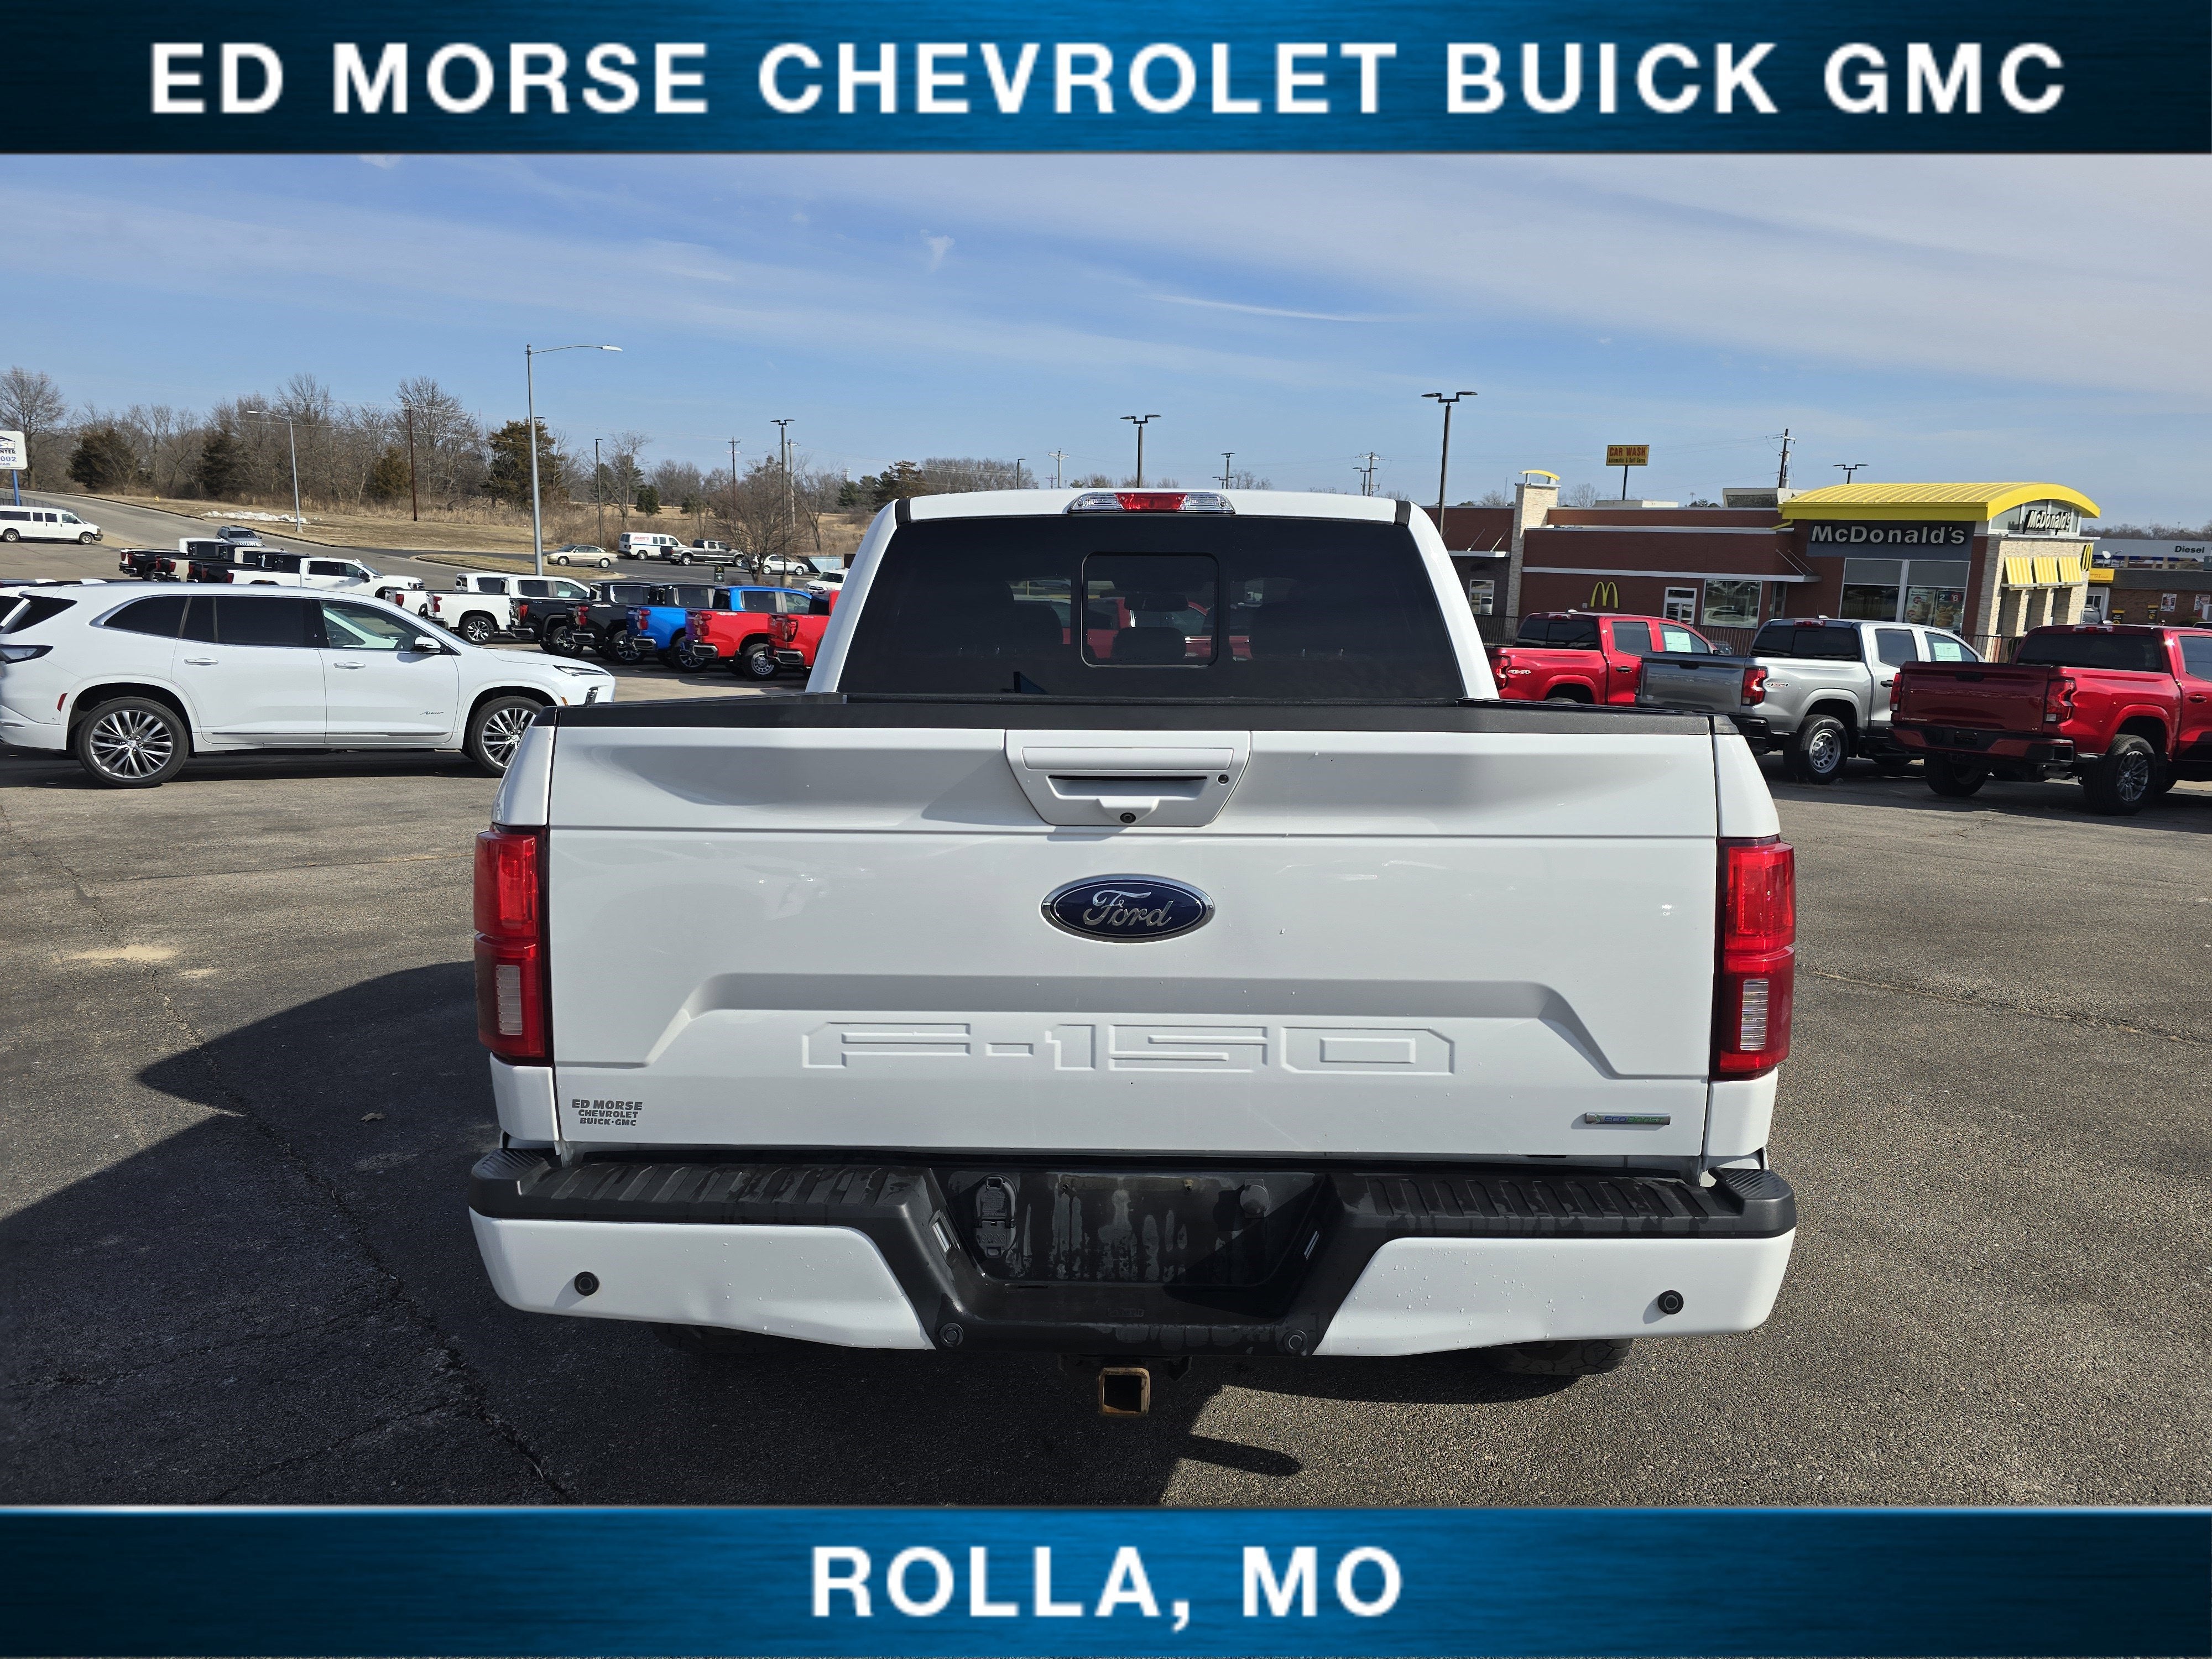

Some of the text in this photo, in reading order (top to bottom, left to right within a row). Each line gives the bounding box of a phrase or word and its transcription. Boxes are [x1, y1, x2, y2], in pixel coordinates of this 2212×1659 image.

[1610, 447, 1646, 456] CAR WASH
[2027, 510, 2071, 529] McDonald's
[1811, 525, 1965, 544] McDonald's
[2174, 545, 2205, 554] Diesel
[1082, 889, 1175, 927] Ford
[800, 1020, 1457, 1076] F-150
[571, 1099, 643, 1111] ED MORSE
[578, 1109, 639, 1119] CHEVROLET
